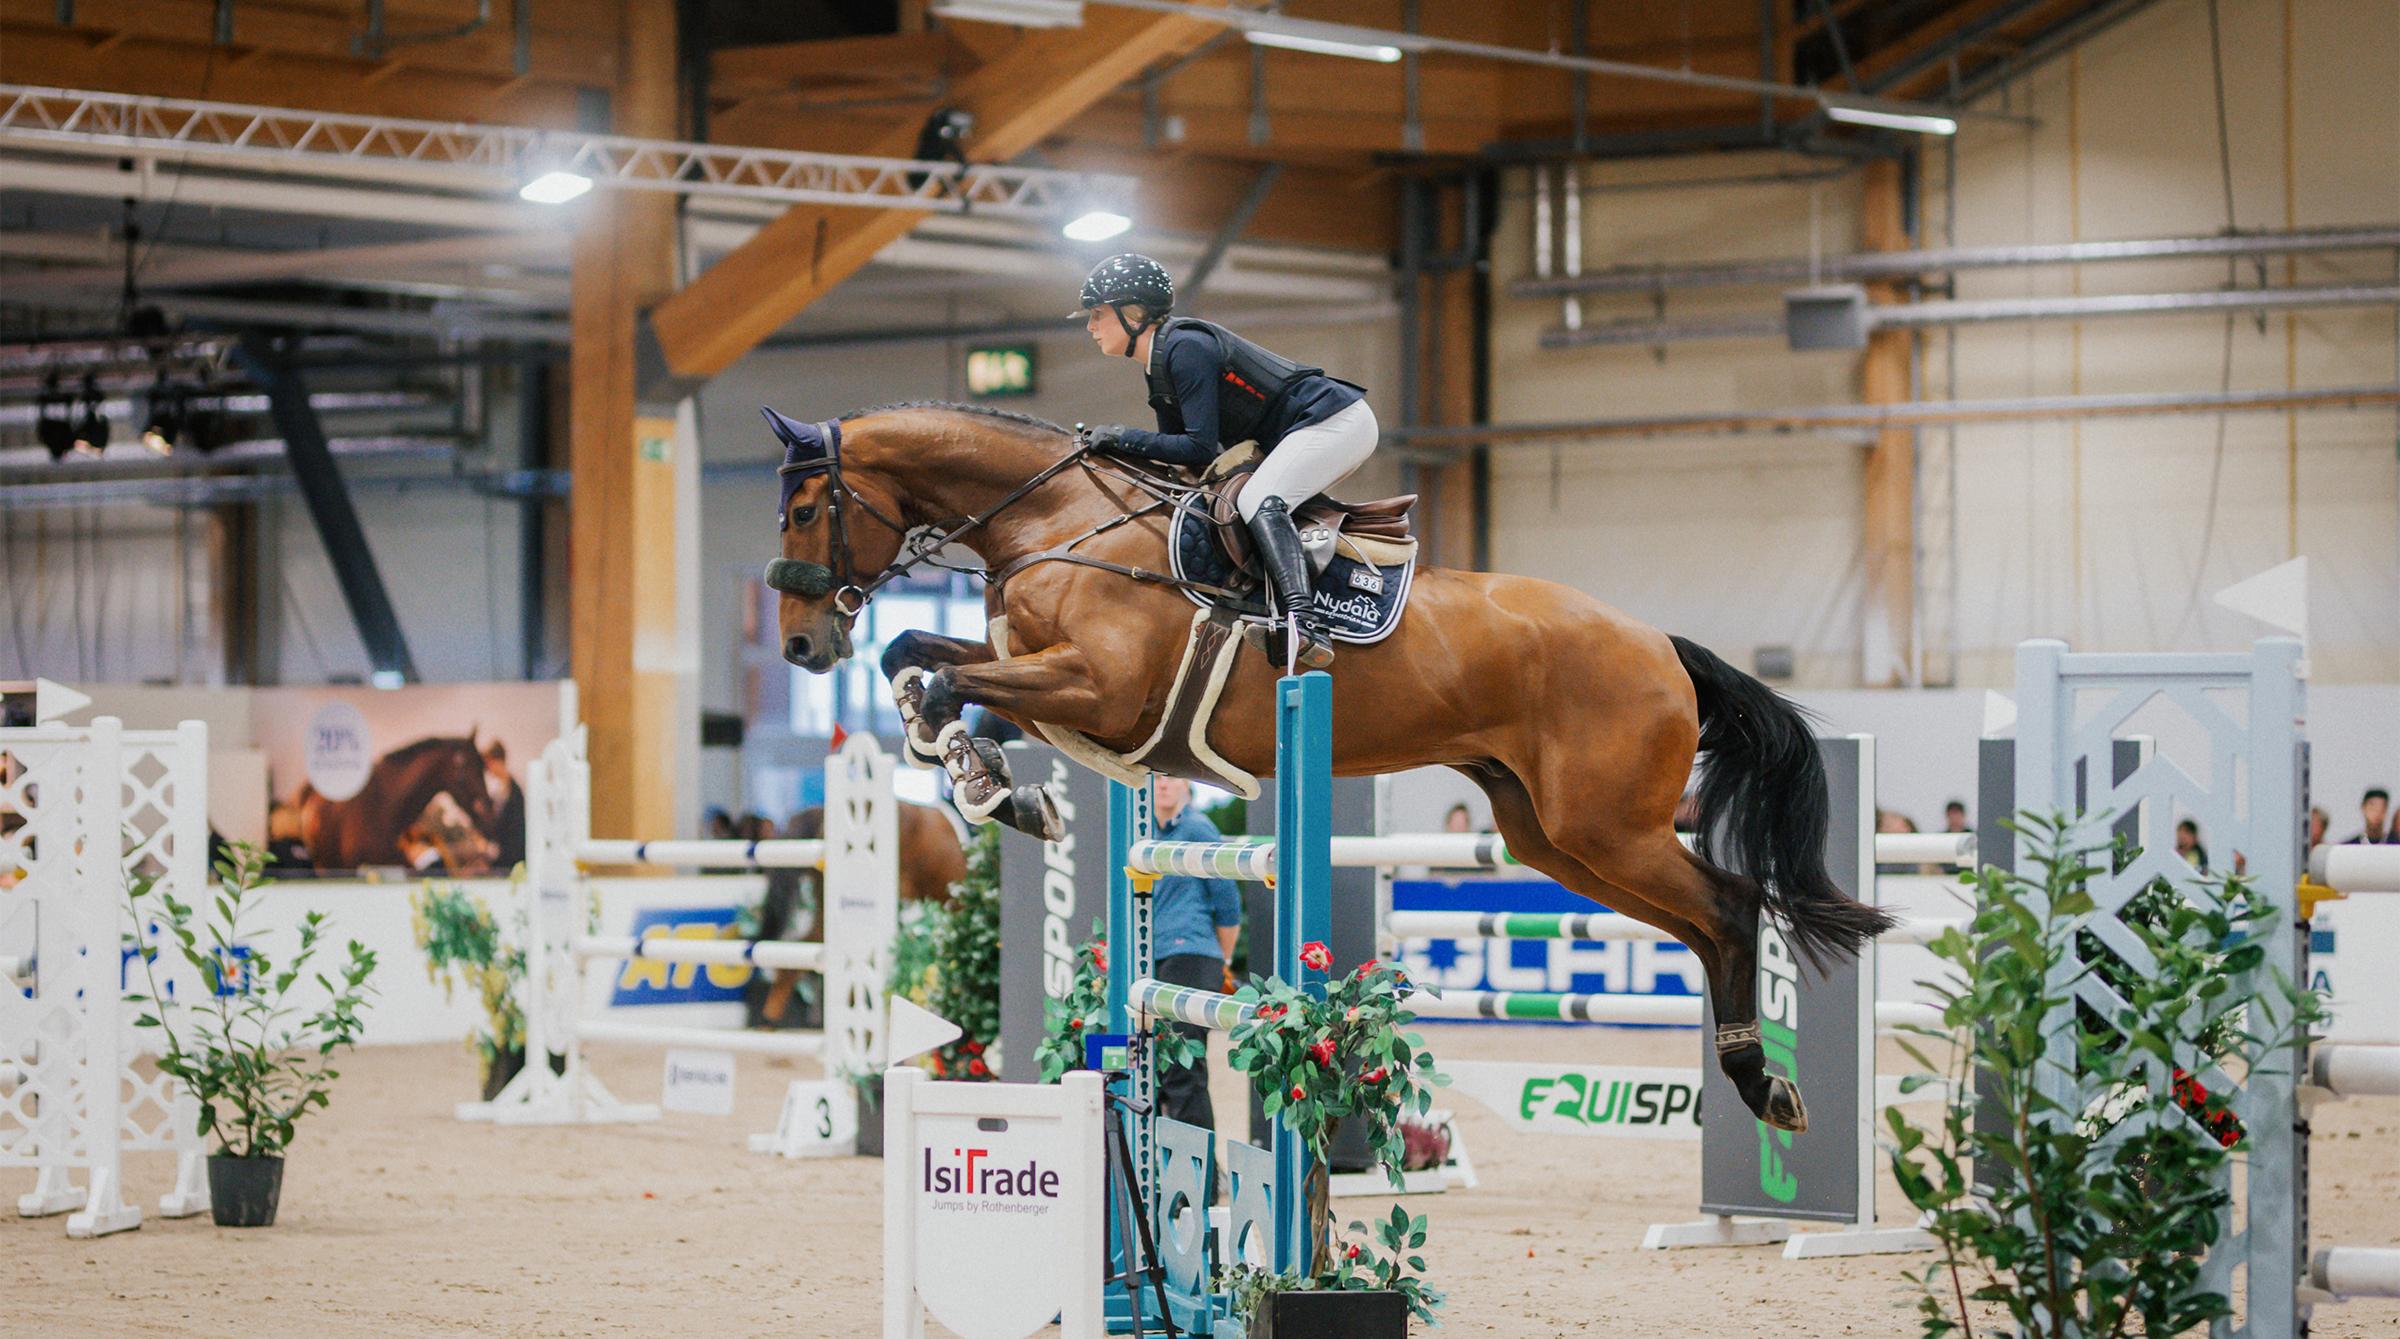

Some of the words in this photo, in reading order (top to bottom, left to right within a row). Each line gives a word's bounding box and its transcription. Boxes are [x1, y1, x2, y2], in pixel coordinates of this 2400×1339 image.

[1354, 575, 1377, 590] 636
[1313, 590, 1378, 622] Nydala
[816, 1097, 832, 1139] 3
[1520, 1073, 1702, 1128] EQUISP
[924, 1147, 1060, 1198] IsiTrade
[932, 1199, 964, 1212] Jumps
[966, 1200, 979, 1213] by
[981, 1200, 1049, 1216] Rothenberger
